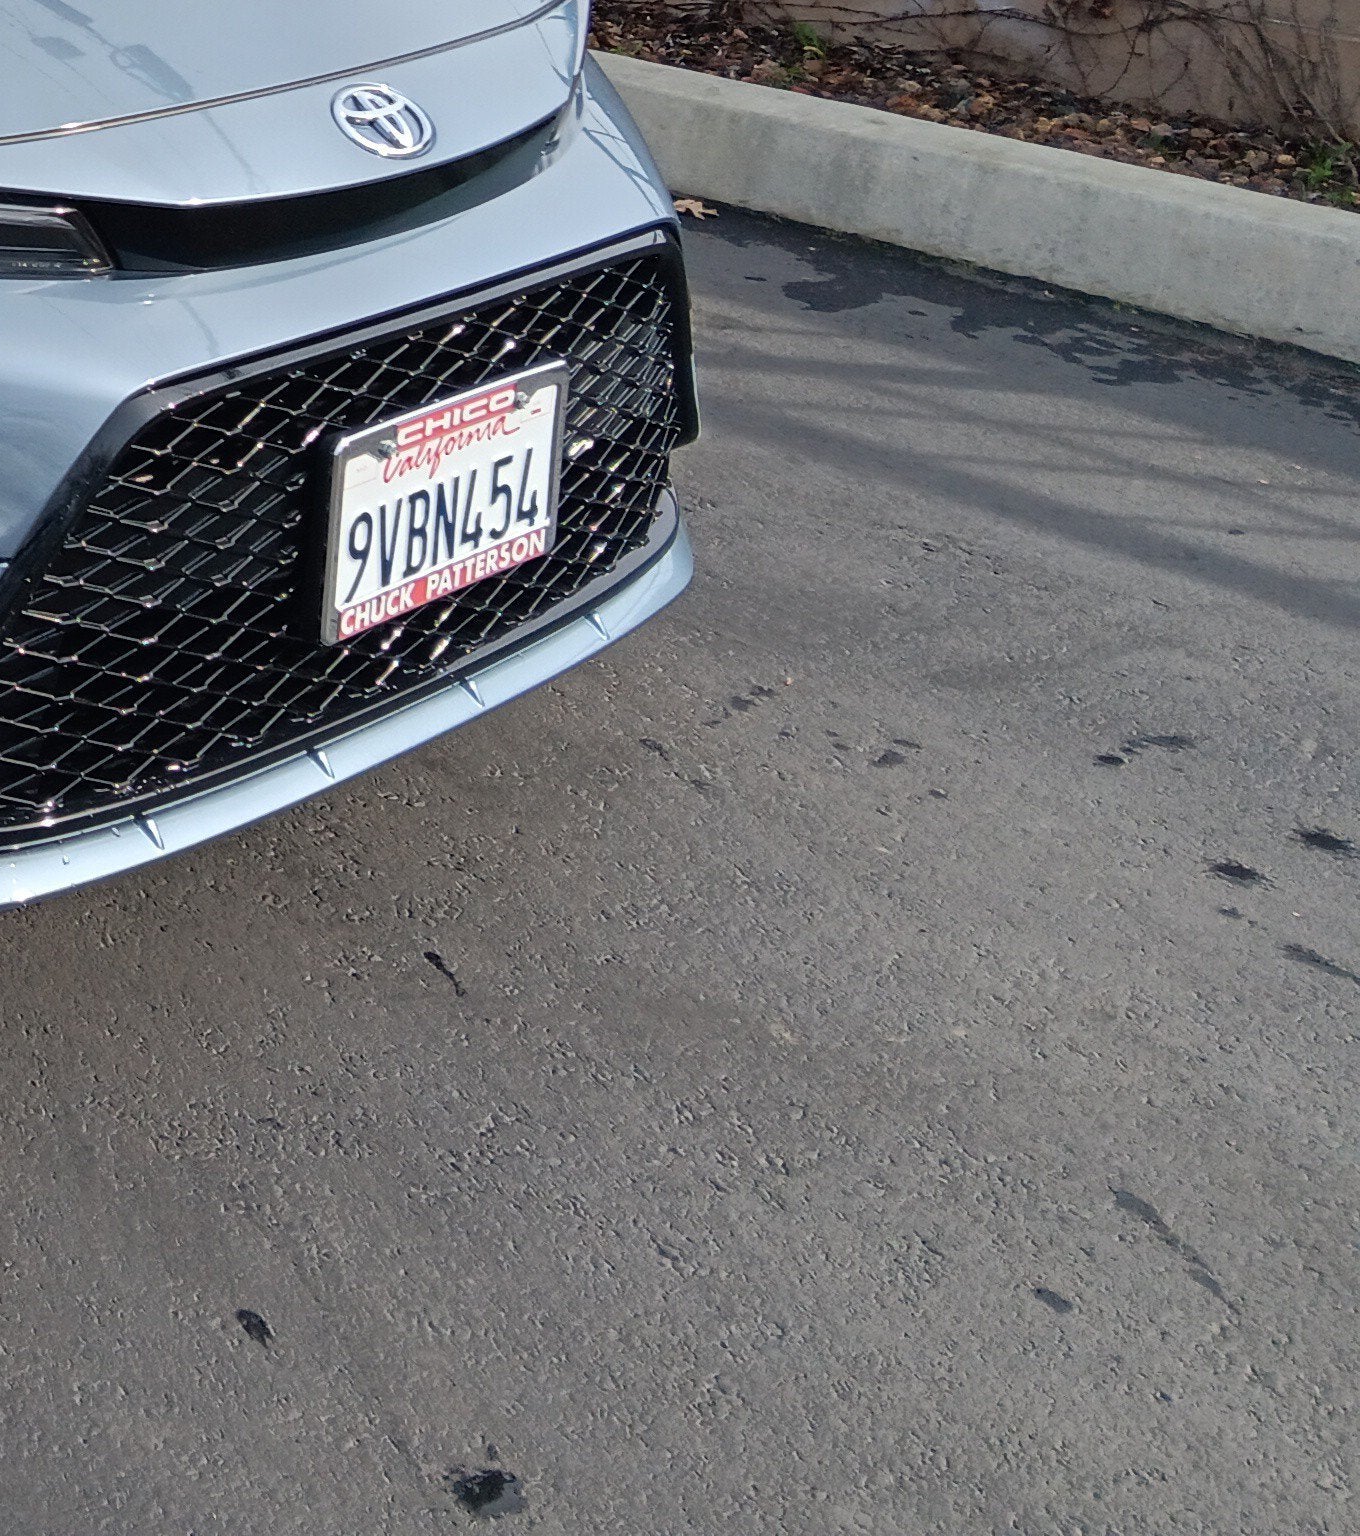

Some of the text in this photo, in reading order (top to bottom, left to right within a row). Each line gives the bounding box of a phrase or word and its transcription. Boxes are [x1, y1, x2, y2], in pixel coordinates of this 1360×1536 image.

[383, 416, 520, 483] California
[397, 389, 516, 447] CHICO
[346, 447, 539, 603] 9VBN454
[340, 528, 546, 635] CHUCK PATTERSON
